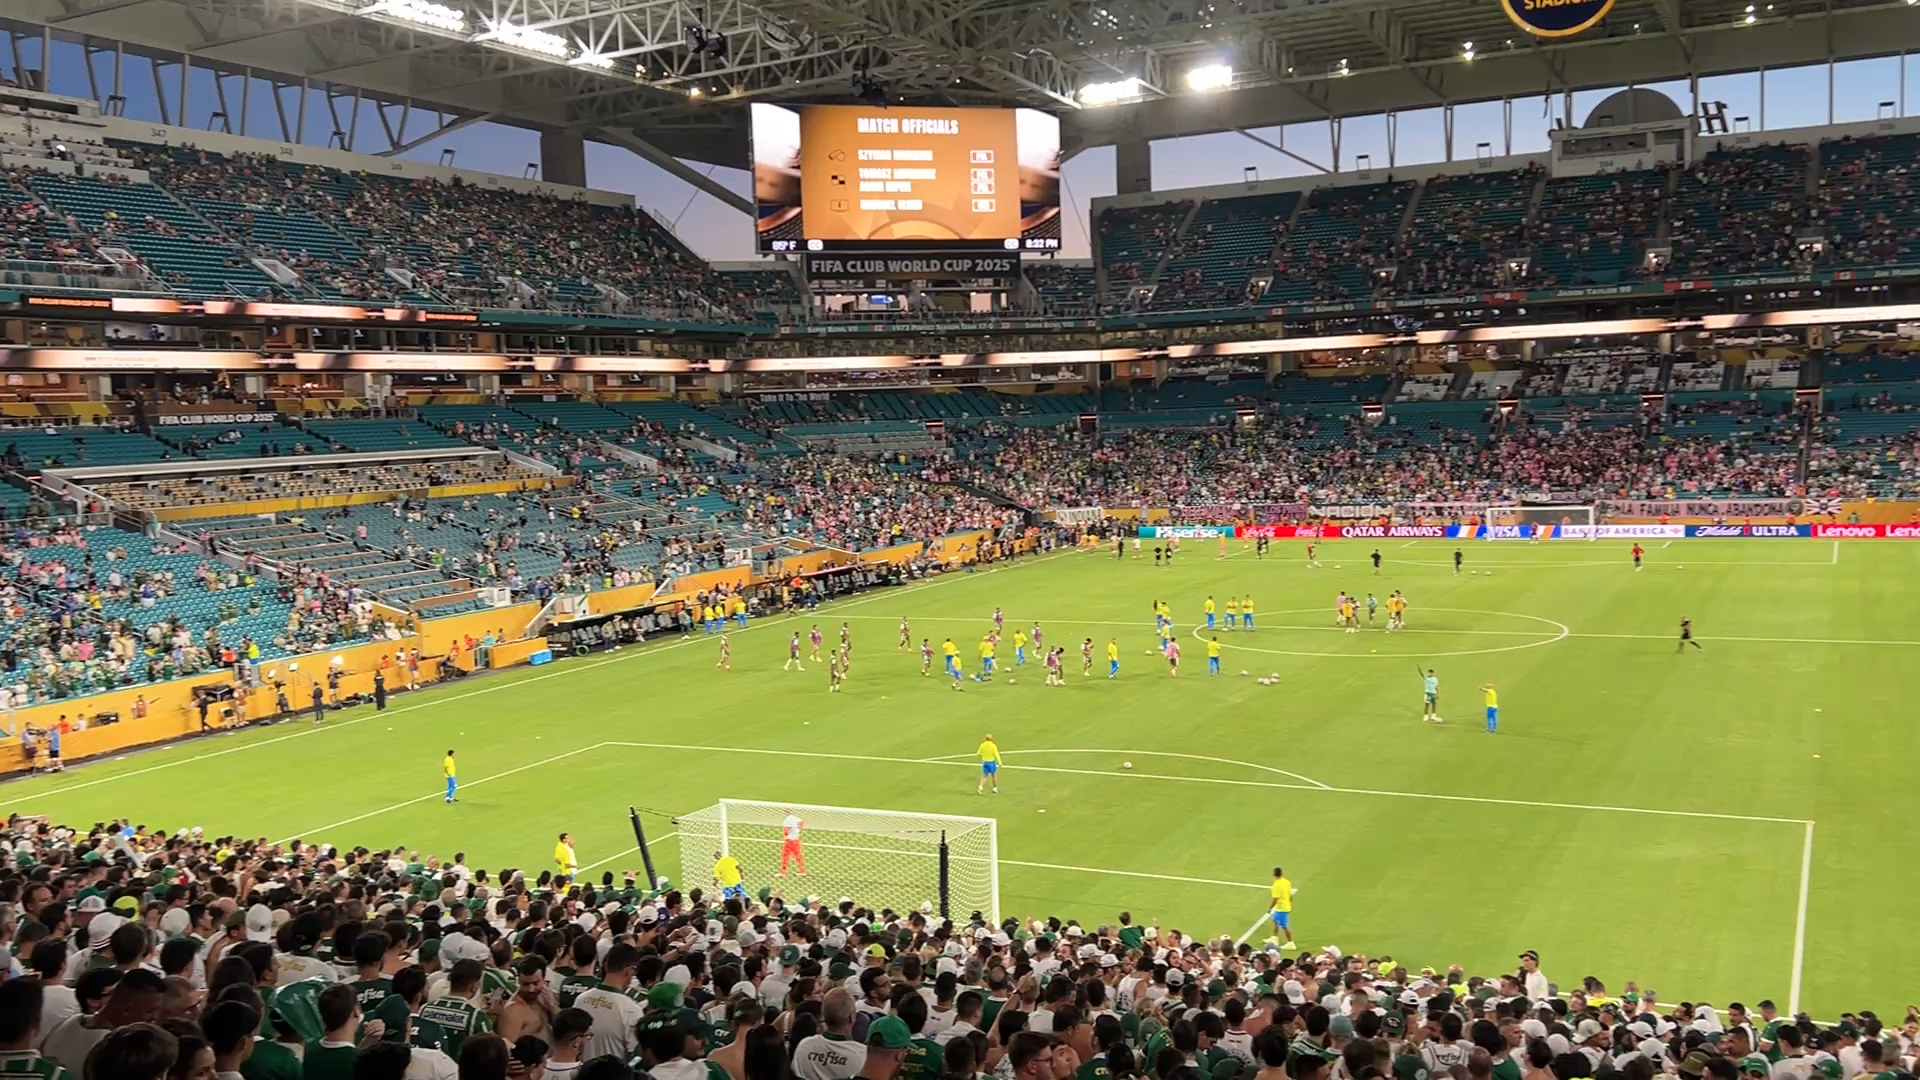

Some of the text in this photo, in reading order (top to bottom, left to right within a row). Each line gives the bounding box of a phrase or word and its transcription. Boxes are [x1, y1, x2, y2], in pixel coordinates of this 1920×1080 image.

[858, 118, 959, 134] MATCH OFFICIALS
[1046, 238, 1058, 248] PM
[812, 260, 844, 272] FIFA
[846, 260, 884, 272] CLUB
[888, 260, 940, 272] WORLD
[943, 259, 972, 272] CUP
[160, 416, 180, 424] FIFA
[180, 416, 203, 424] CLUB
[204, 414, 234, 424] WORLD
[236, 414, 252, 422] CUP
[1687, 503, 1718, 515] NUNCA
[1726, 502, 1784, 516] ABANDONA
[1342, 526, 1442, 538] QATAR AIRWAYS
[1494, 526, 1520, 537] VISA
[1598, 527, 1610, 535] OF
[1752, 526, 1799, 536] ULTRA
[1817, 525, 1876, 536] Lenovo
[356, 988, 385, 1004] efisa
[808, 1052, 848, 1066] crefisa
